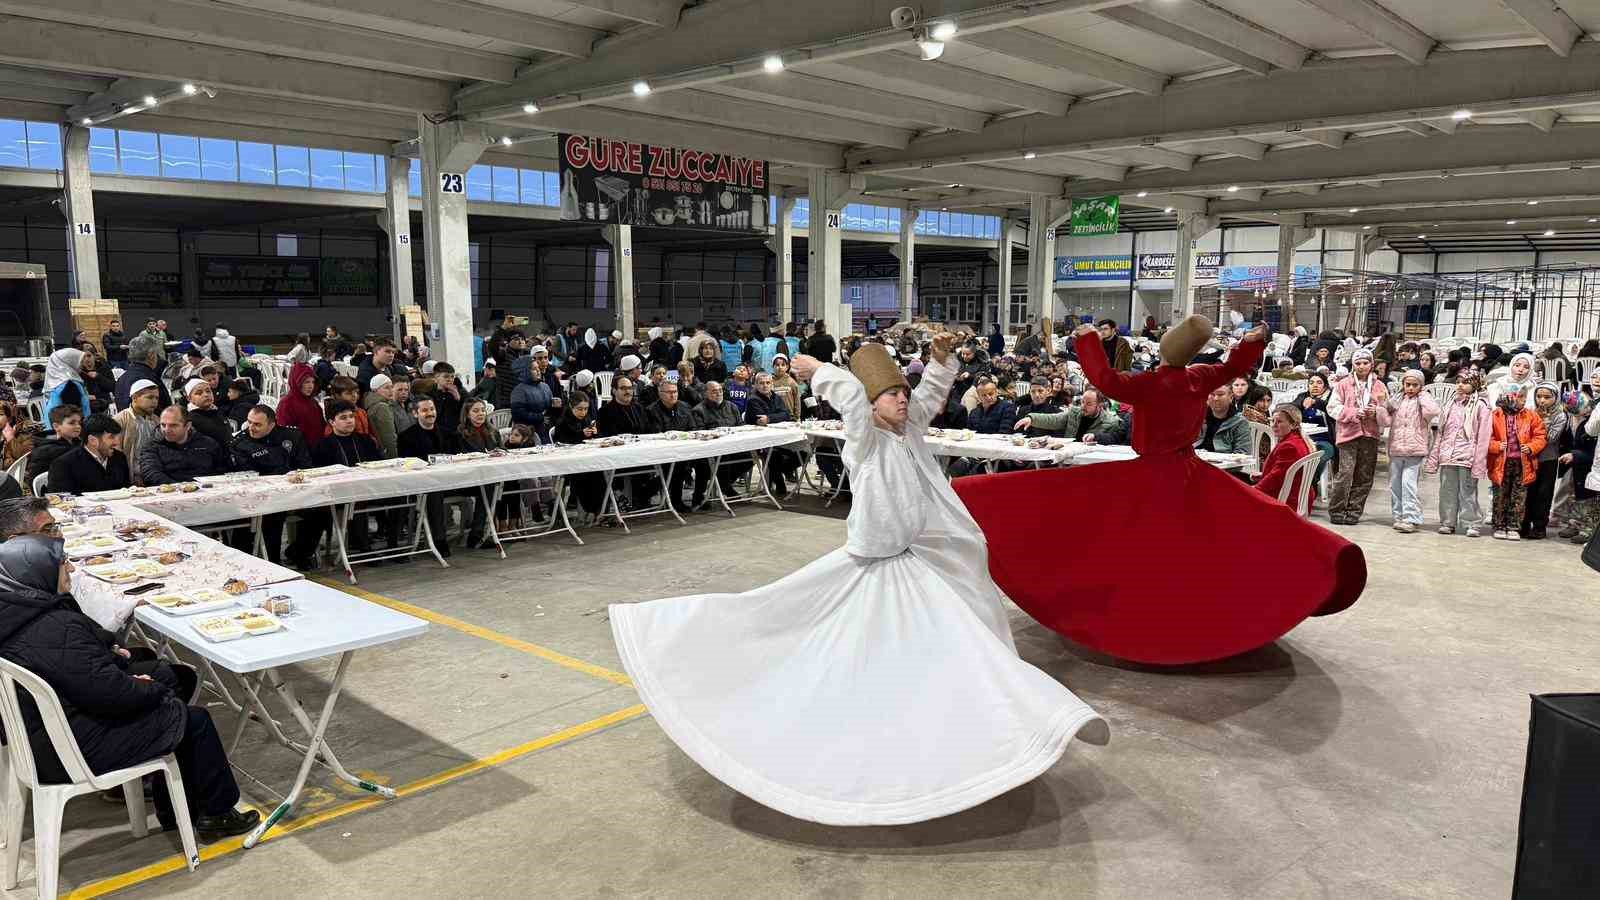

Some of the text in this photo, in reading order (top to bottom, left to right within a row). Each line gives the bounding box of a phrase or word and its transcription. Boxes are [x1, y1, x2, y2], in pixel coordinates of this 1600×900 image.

[565, 134, 765, 188] GÜRE ZÜCCAİYE
[442, 174, 463, 193] 23
[828, 215, 839, 228] 24
[77, 224, 91, 234] 14
[1047, 229, 1055, 241] 25
[399, 235, 408, 244] 15
[1074, 260, 1093, 270] UMUT
